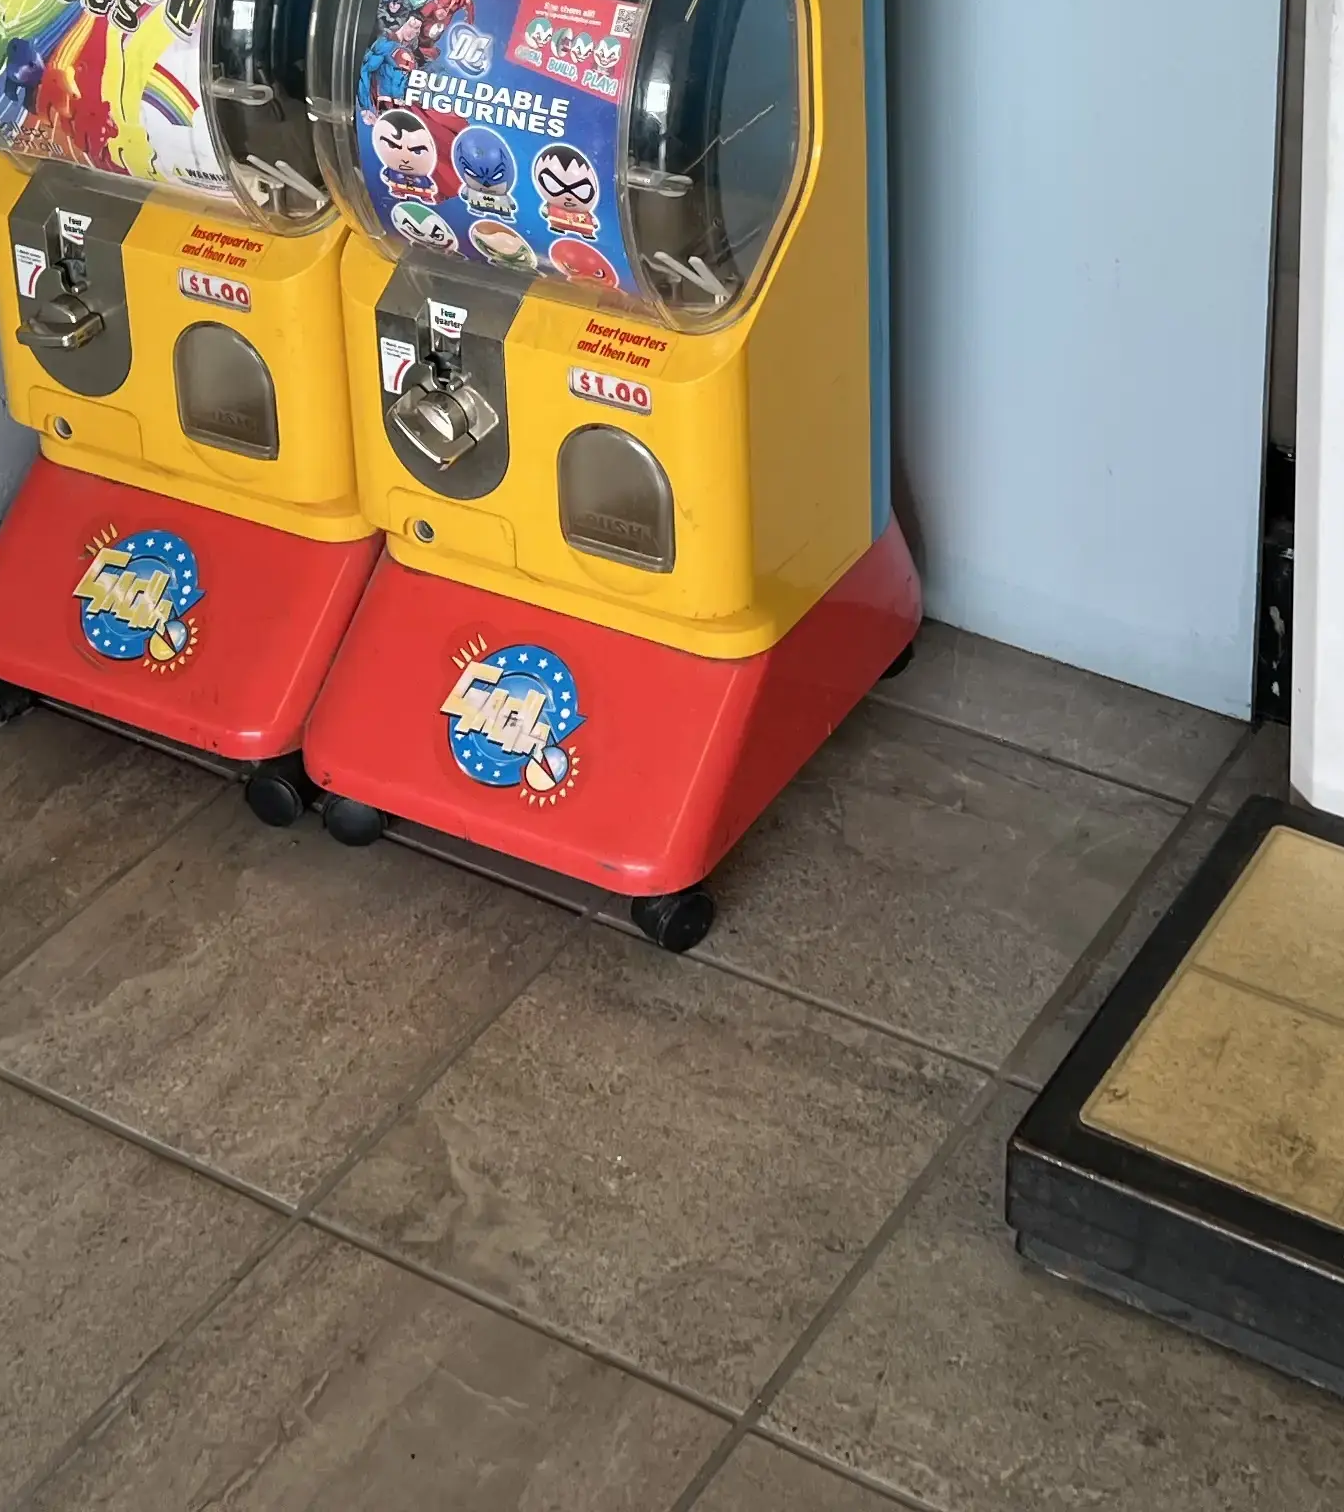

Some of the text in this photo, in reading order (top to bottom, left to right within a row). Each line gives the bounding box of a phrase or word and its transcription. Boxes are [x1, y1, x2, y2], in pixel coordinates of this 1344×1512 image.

[560, 4, 582, 17] them
[546, 56, 578, 81] BUILD,
[581, 68, 619, 97] PLAY!
[408, 68, 570, 120] BUILDABLE
[404, 88, 566, 139] FIGURINES
[191, 224, 264, 253] Insert quarters
[181, 243, 247, 268] and then turn
[188, 273, 250, 306] $1.00
[440, 307, 456, 319] Four
[586, 318, 668, 353] Insert quarters
[577, 338, 651, 369] and then turn
[579, 373, 649, 407] $1.00
